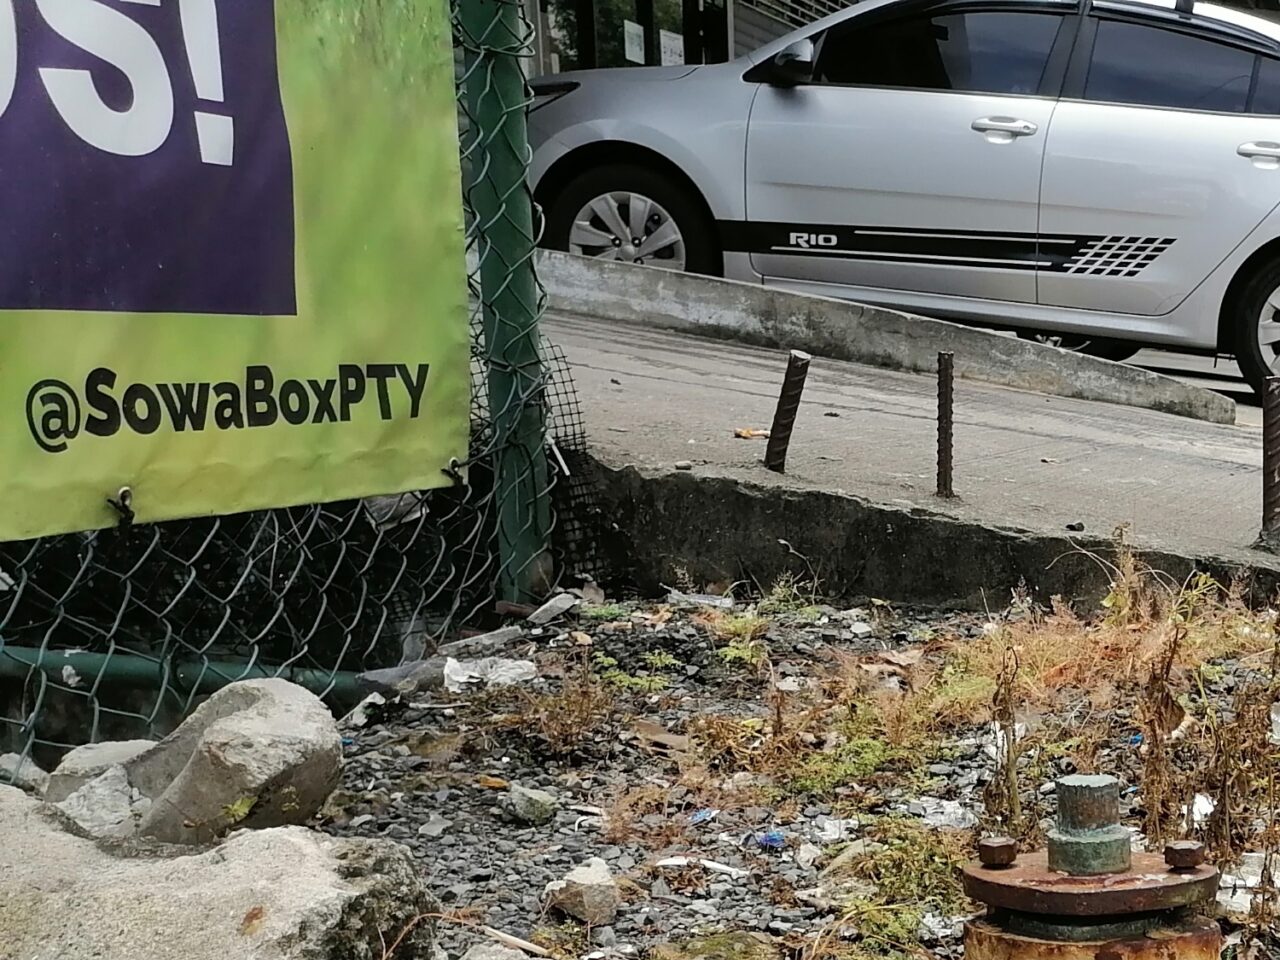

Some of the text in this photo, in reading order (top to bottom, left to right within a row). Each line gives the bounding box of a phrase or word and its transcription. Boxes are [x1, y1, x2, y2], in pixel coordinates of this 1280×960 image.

[0, 0, 234, 166] S!
[789, 232, 838, 248] RIO
[26, 363, 430, 453] @SowaBoxPTY
